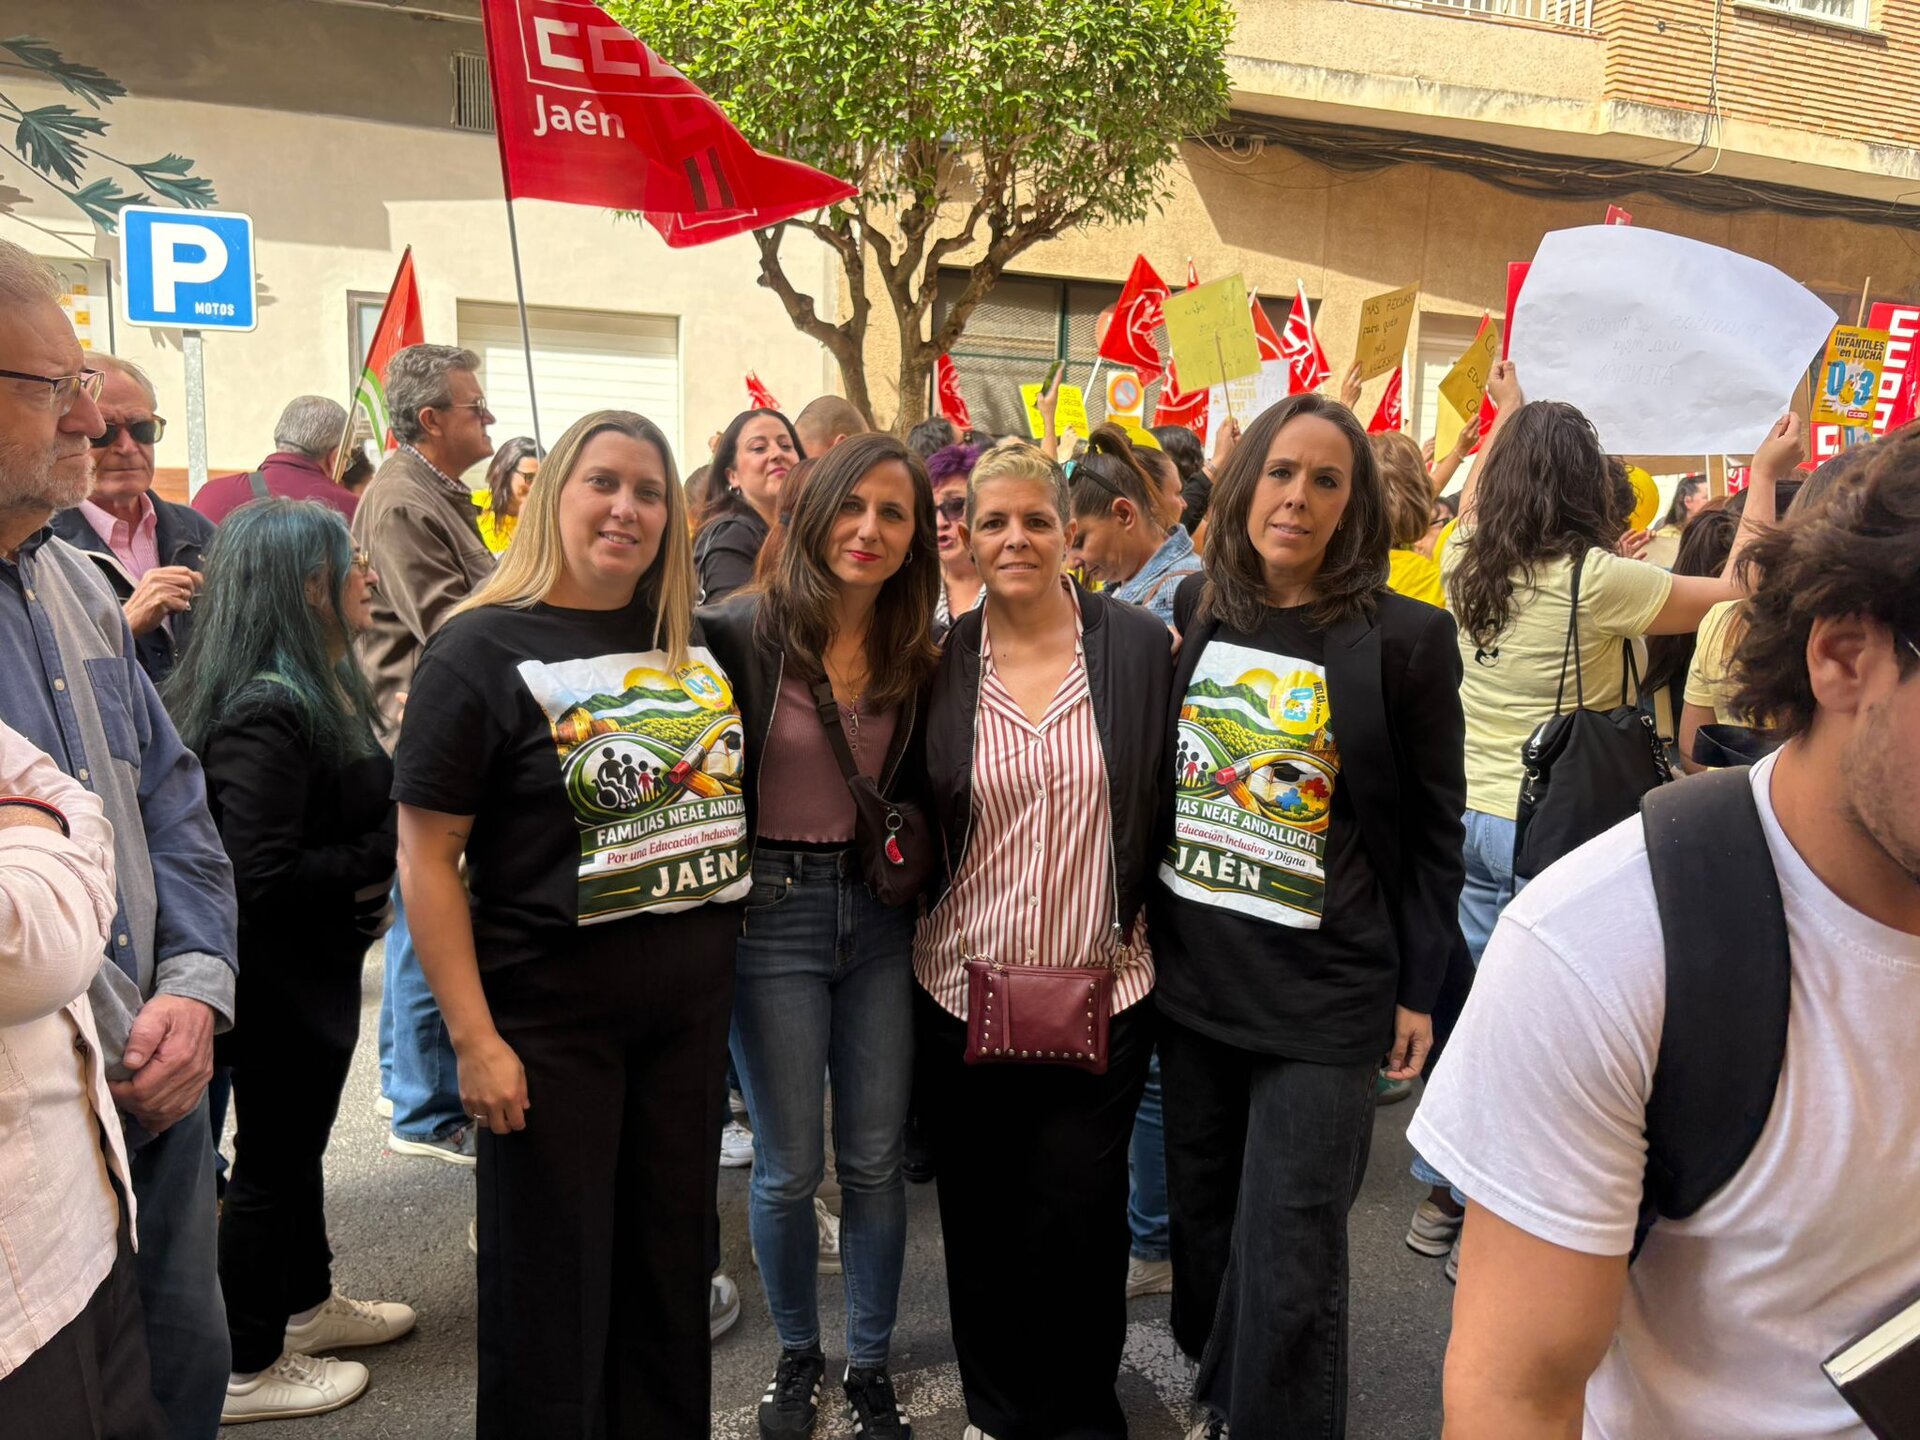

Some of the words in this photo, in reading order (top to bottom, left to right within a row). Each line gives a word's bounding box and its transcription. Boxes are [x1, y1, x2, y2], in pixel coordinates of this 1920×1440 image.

[533, 94, 625, 139] Jaén
[150, 221, 229, 313] P
[194, 301, 235, 317] MOTOS
[1835, 336, 1885, 351] INFANTILES
[1840, 349, 1851, 358] en
[1853, 348, 1882, 361] LUCHA
[597, 816, 665, 846] FAMILIAS
[669, 803, 706, 826] NEAE
[1177, 821, 1224, 843] Educación
[1225, 833, 1266, 857] Inclusiva
[1266, 850, 1274, 860] y
[1275, 849, 1306, 868] Digna
[1202, 801, 1238, 826] NEAE
[1239, 814, 1318, 853] ANDALUCÍA
[606, 850, 628, 865] Por
[629, 847, 648, 861] una
[649, 833, 700, 855] Educación
[1175, 846, 1261, 891] JAÉN
[651, 849, 739, 897] JAÉN
